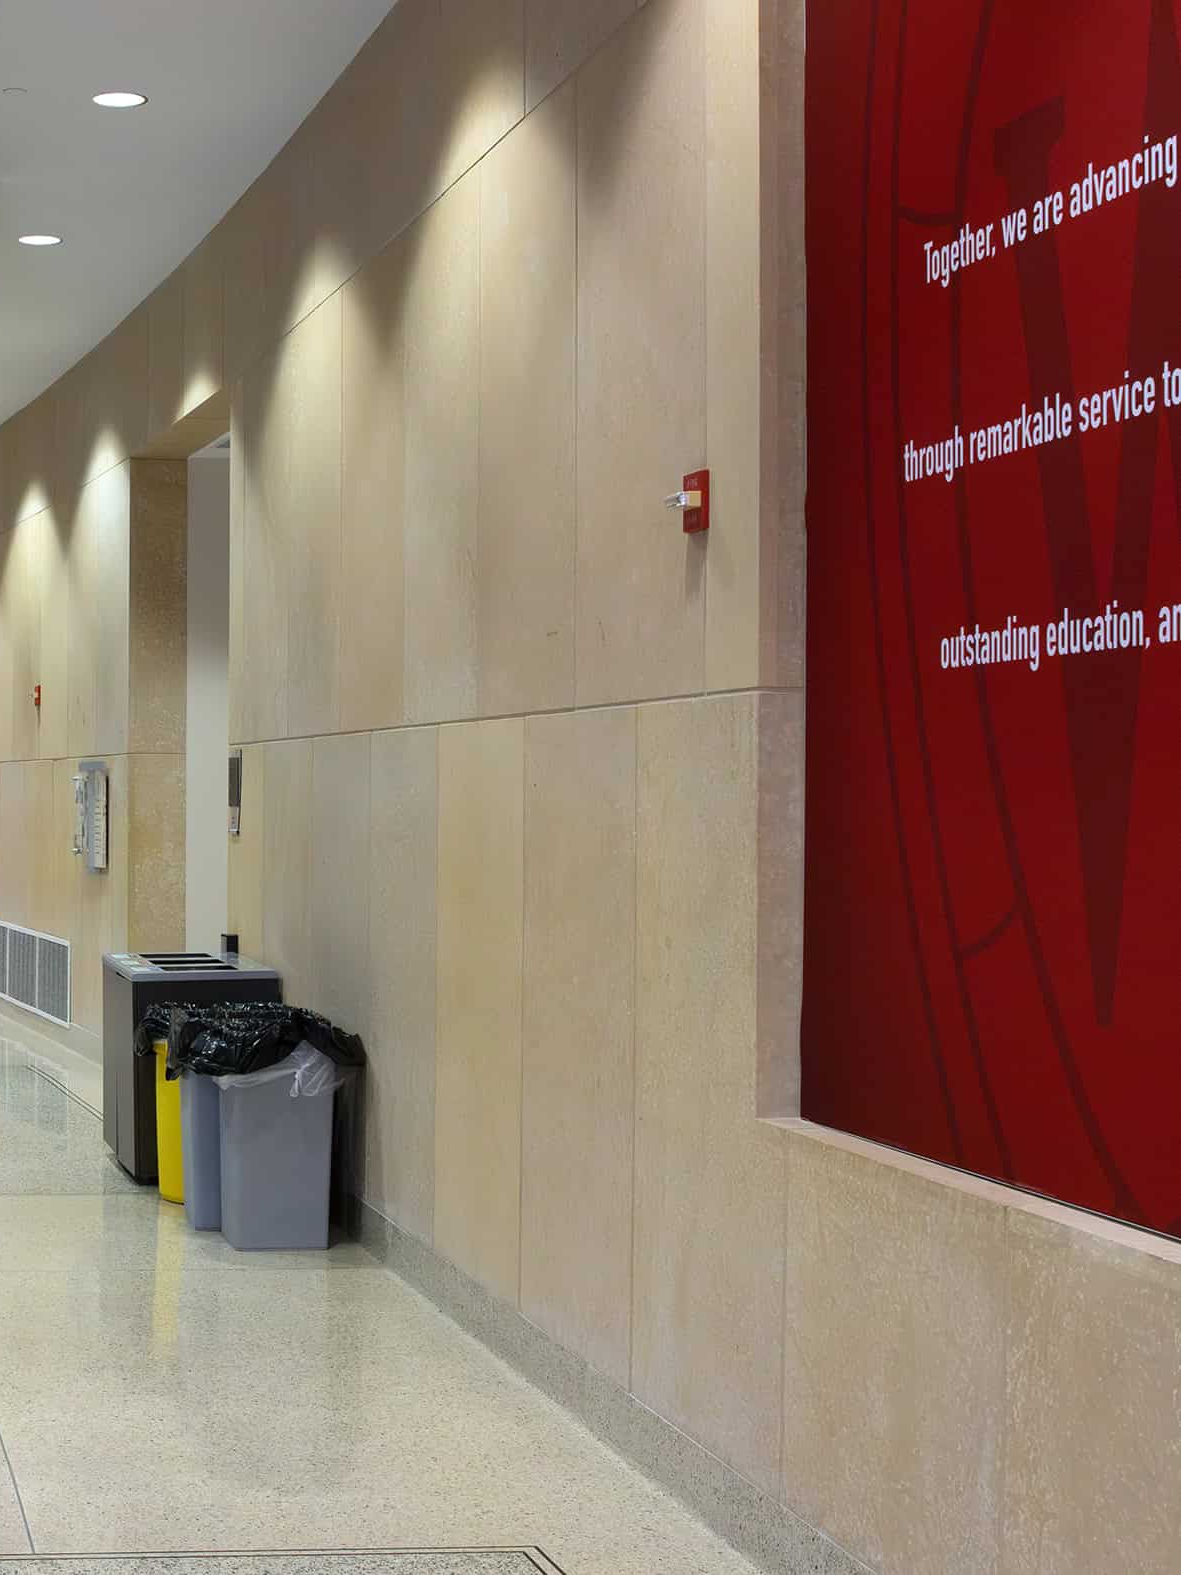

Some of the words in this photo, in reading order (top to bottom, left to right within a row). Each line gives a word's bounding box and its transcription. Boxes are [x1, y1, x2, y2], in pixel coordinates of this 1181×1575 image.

[923, 222, 997, 288] Together,
[1000, 207, 1027, 249] we
[1032, 191, 1064, 235] are
[1069, 134, 1179, 219] advancing
[903, 424, 964, 483] through
[969, 392, 1073, 465] remarkable
[1078, 369, 1156, 433] service
[1161, 360, 1181, 408] to
[940, 615, 1040, 672] outstanding
[1046, 599, 1151, 657] education,
